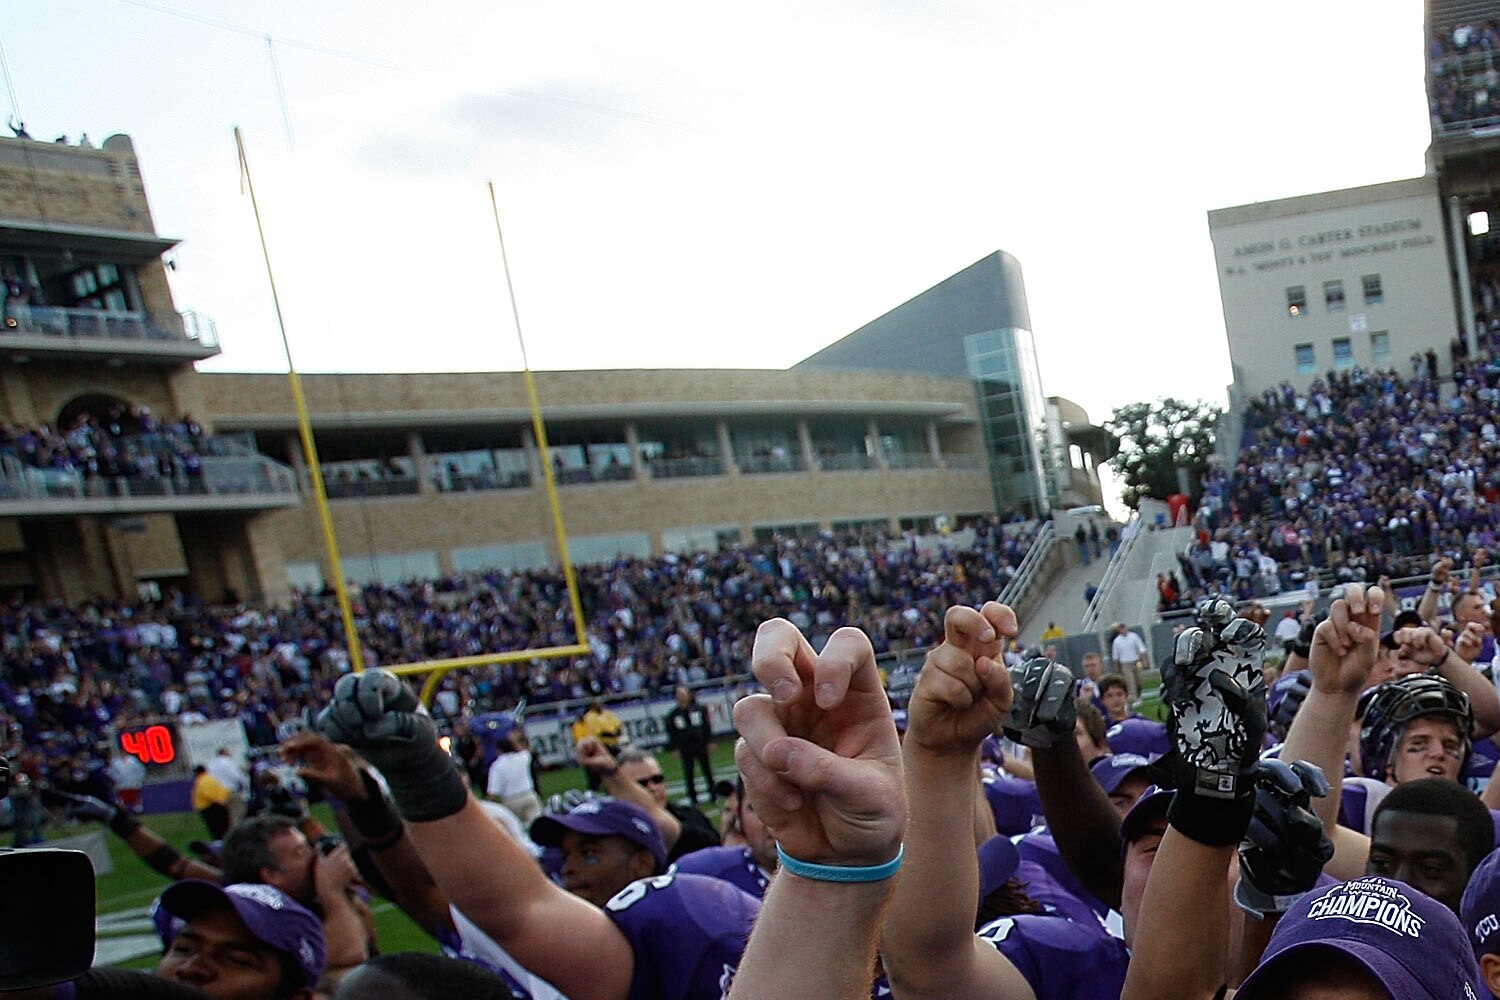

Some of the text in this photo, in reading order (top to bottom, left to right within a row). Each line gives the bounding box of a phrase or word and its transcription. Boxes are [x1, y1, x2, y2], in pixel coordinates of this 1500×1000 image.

[1298, 228, 1354, 246] CARTER
[1358, 217, 1421, 238] STADIUM
[120, 724, 176, 764] 40
[1343, 881, 1398, 899] MOUNTAIN
[1307, 895, 1422, 938] CHAMPIONS
[1475, 914, 1500, 943] TCU
